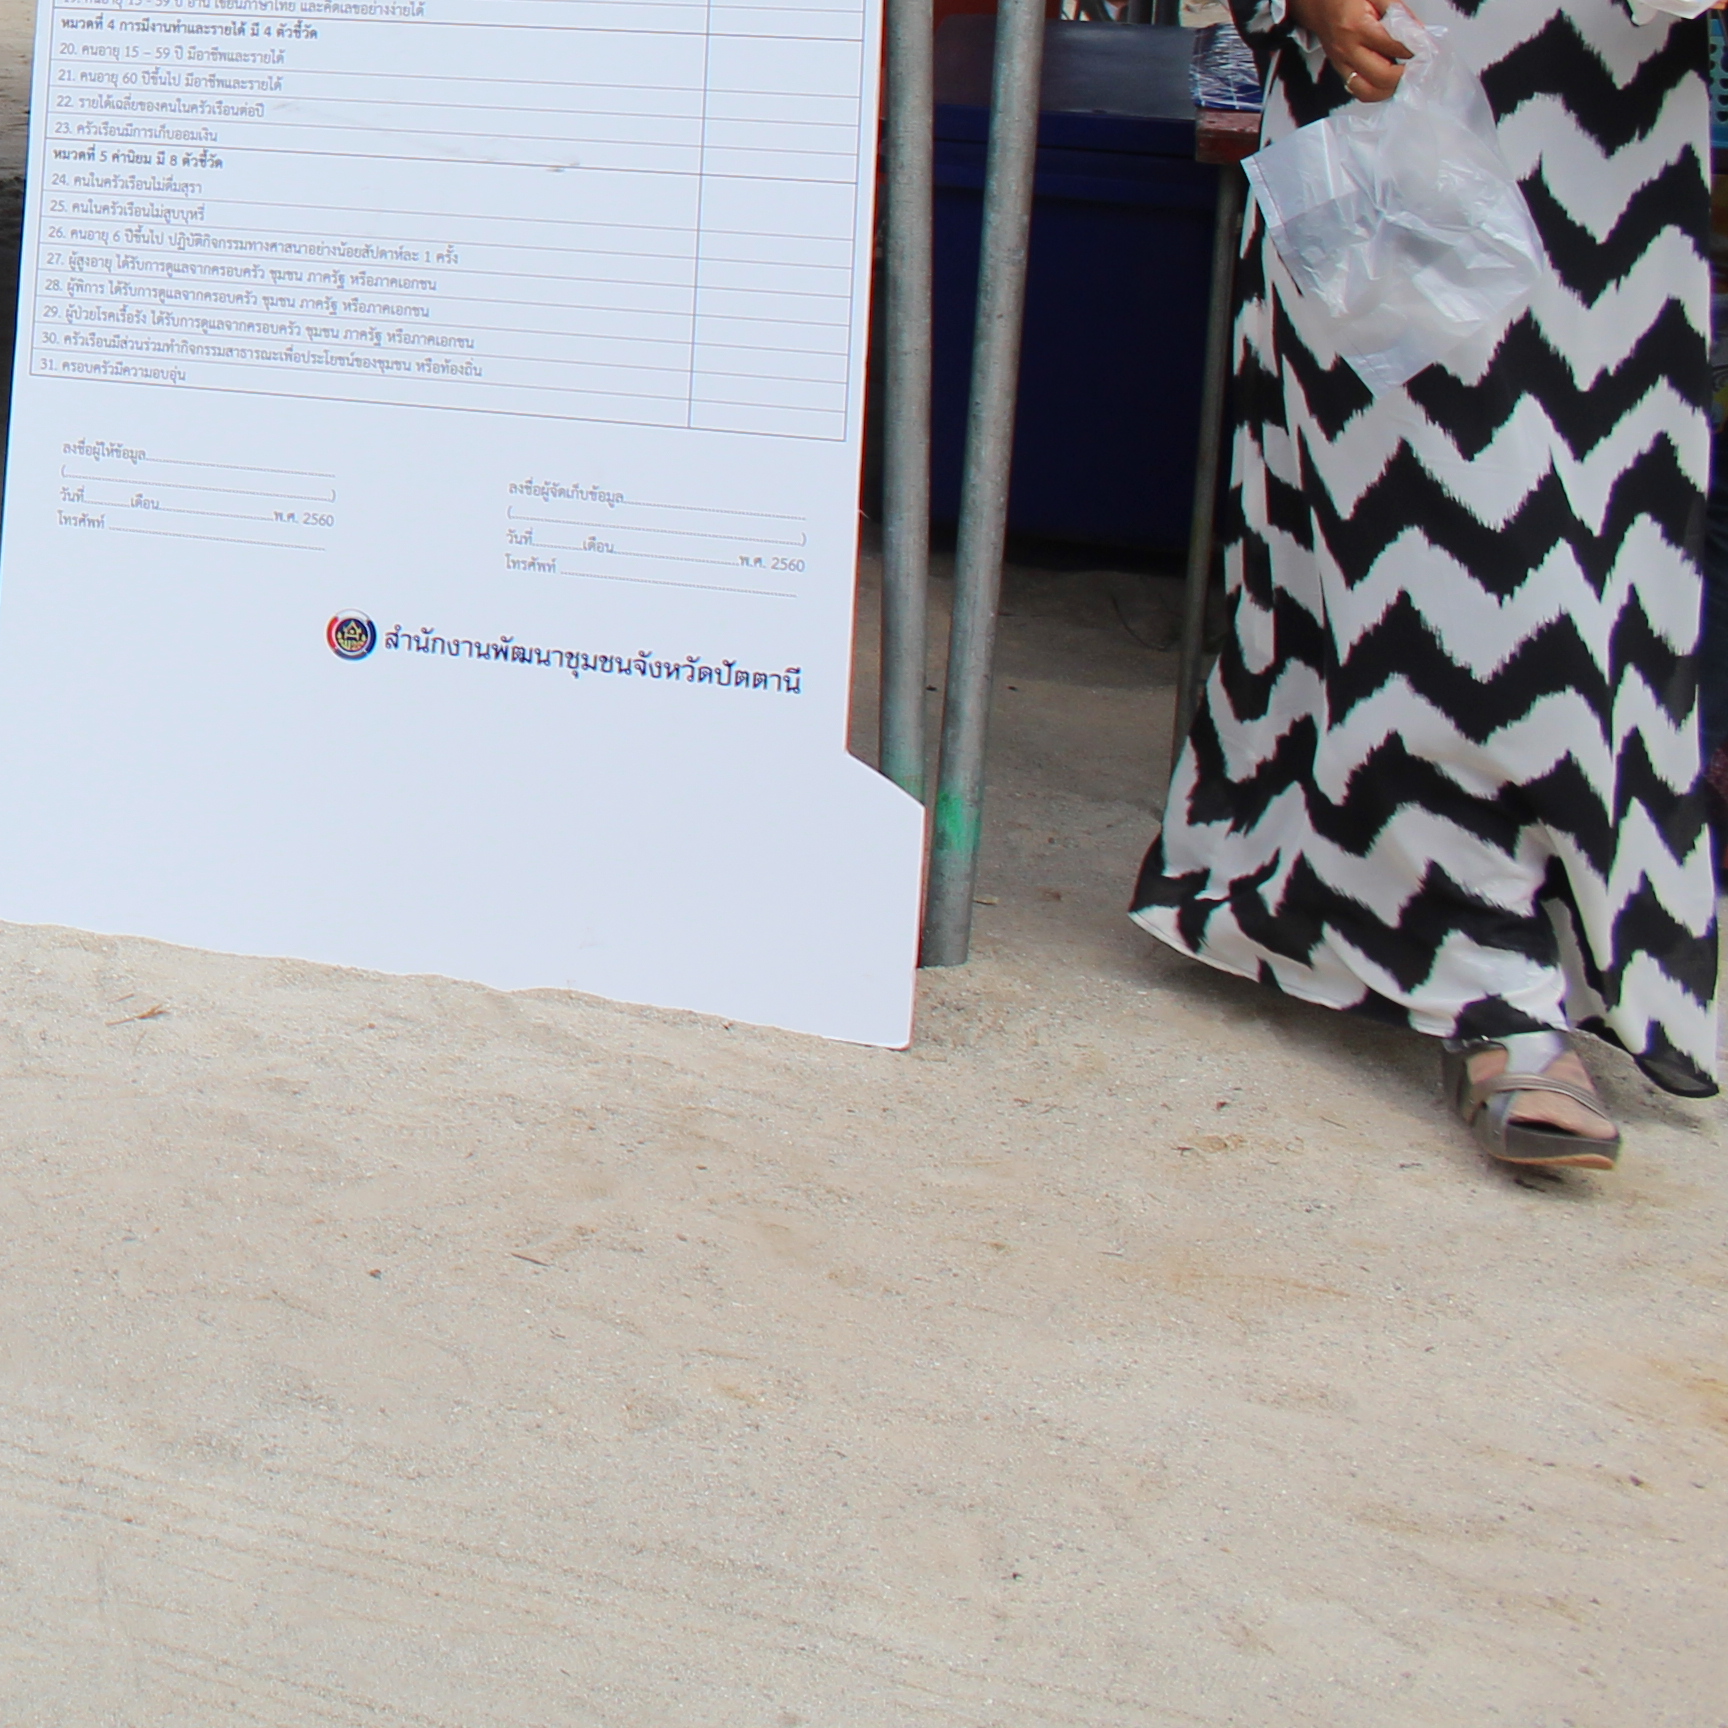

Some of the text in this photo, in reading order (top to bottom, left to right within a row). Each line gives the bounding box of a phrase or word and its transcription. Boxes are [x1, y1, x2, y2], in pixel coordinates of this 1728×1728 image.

[61, 12, 317, 38] หมวดที่ 4 การมีงานทำและรายได้ มี 4 ตัวชี้วัด
[52, 143, 222, 168] หมวดที่ 5 ค่านิยม มี 8 ตัวชี้วัด
[385, 624, 800, 693] สำนักงานพัฒนาชุมชนจังหวัดปัตตานี
